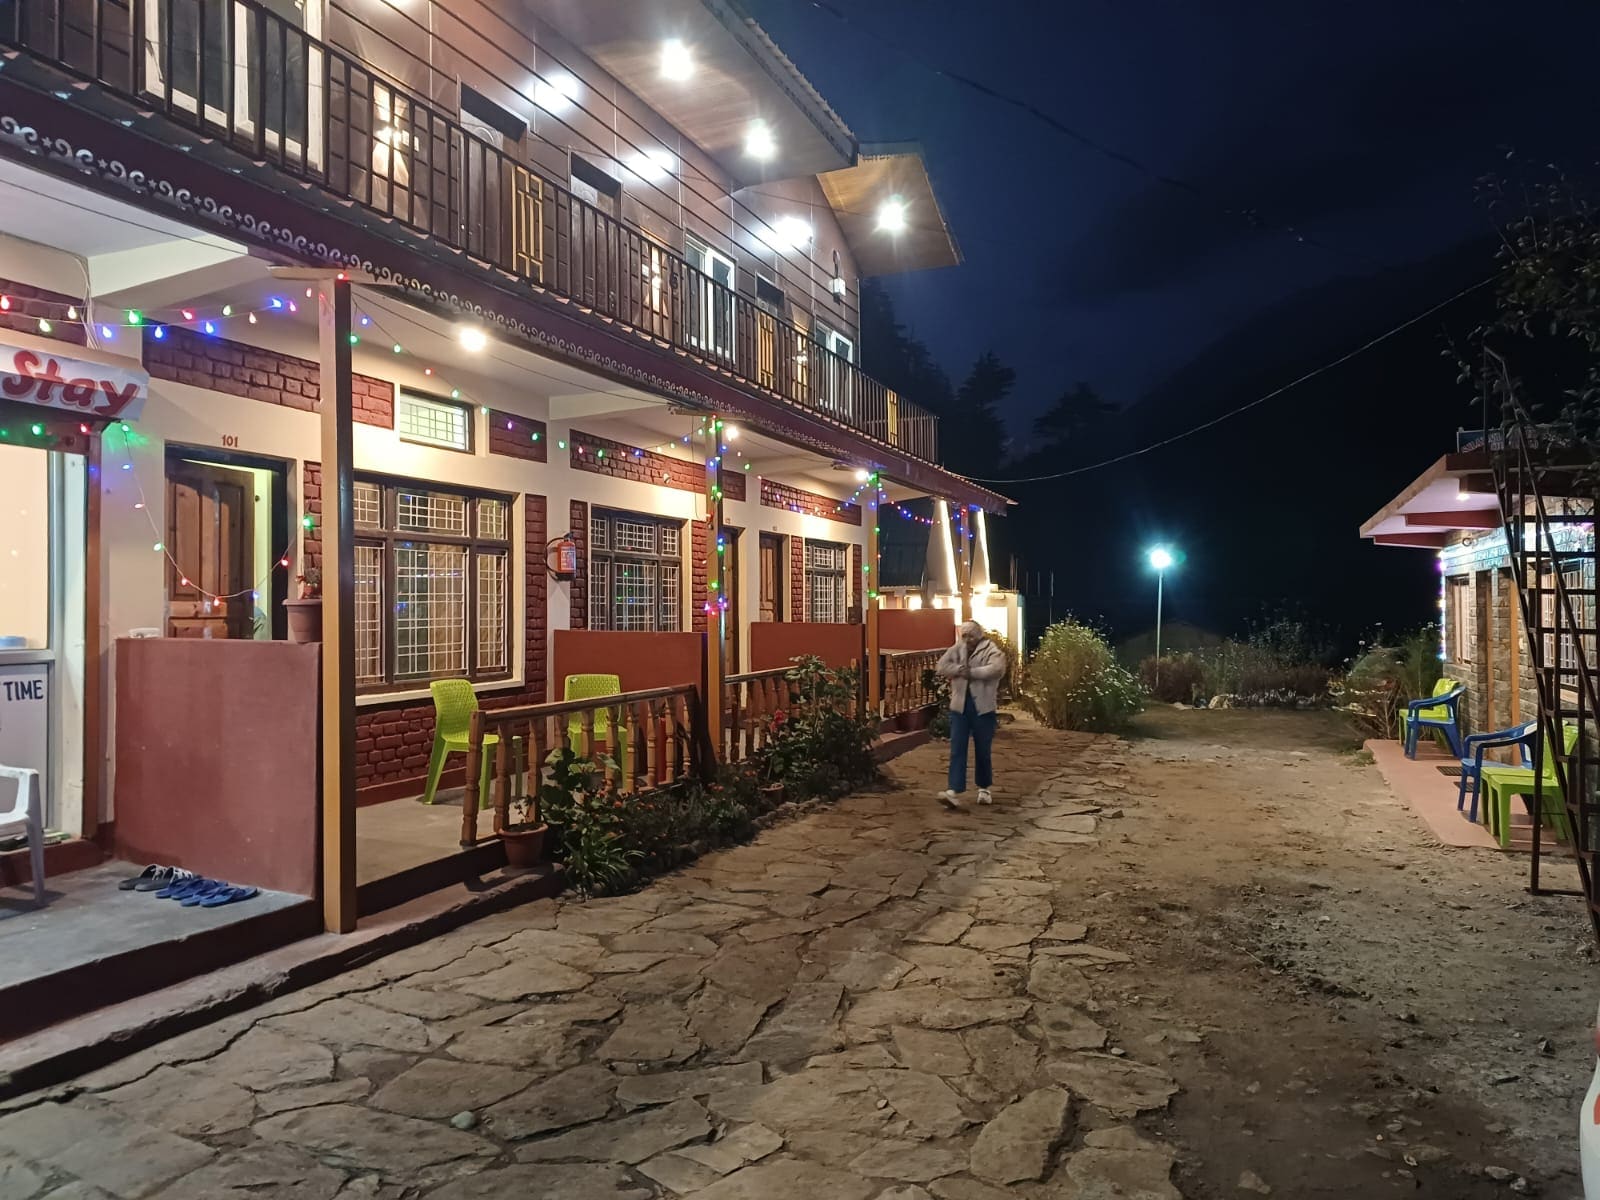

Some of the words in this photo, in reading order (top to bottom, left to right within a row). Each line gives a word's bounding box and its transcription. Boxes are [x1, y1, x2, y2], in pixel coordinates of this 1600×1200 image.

[2, 350, 139, 416] Stay
[222, 434, 238, 448] 101
[3, 680, 44, 701] TIME
